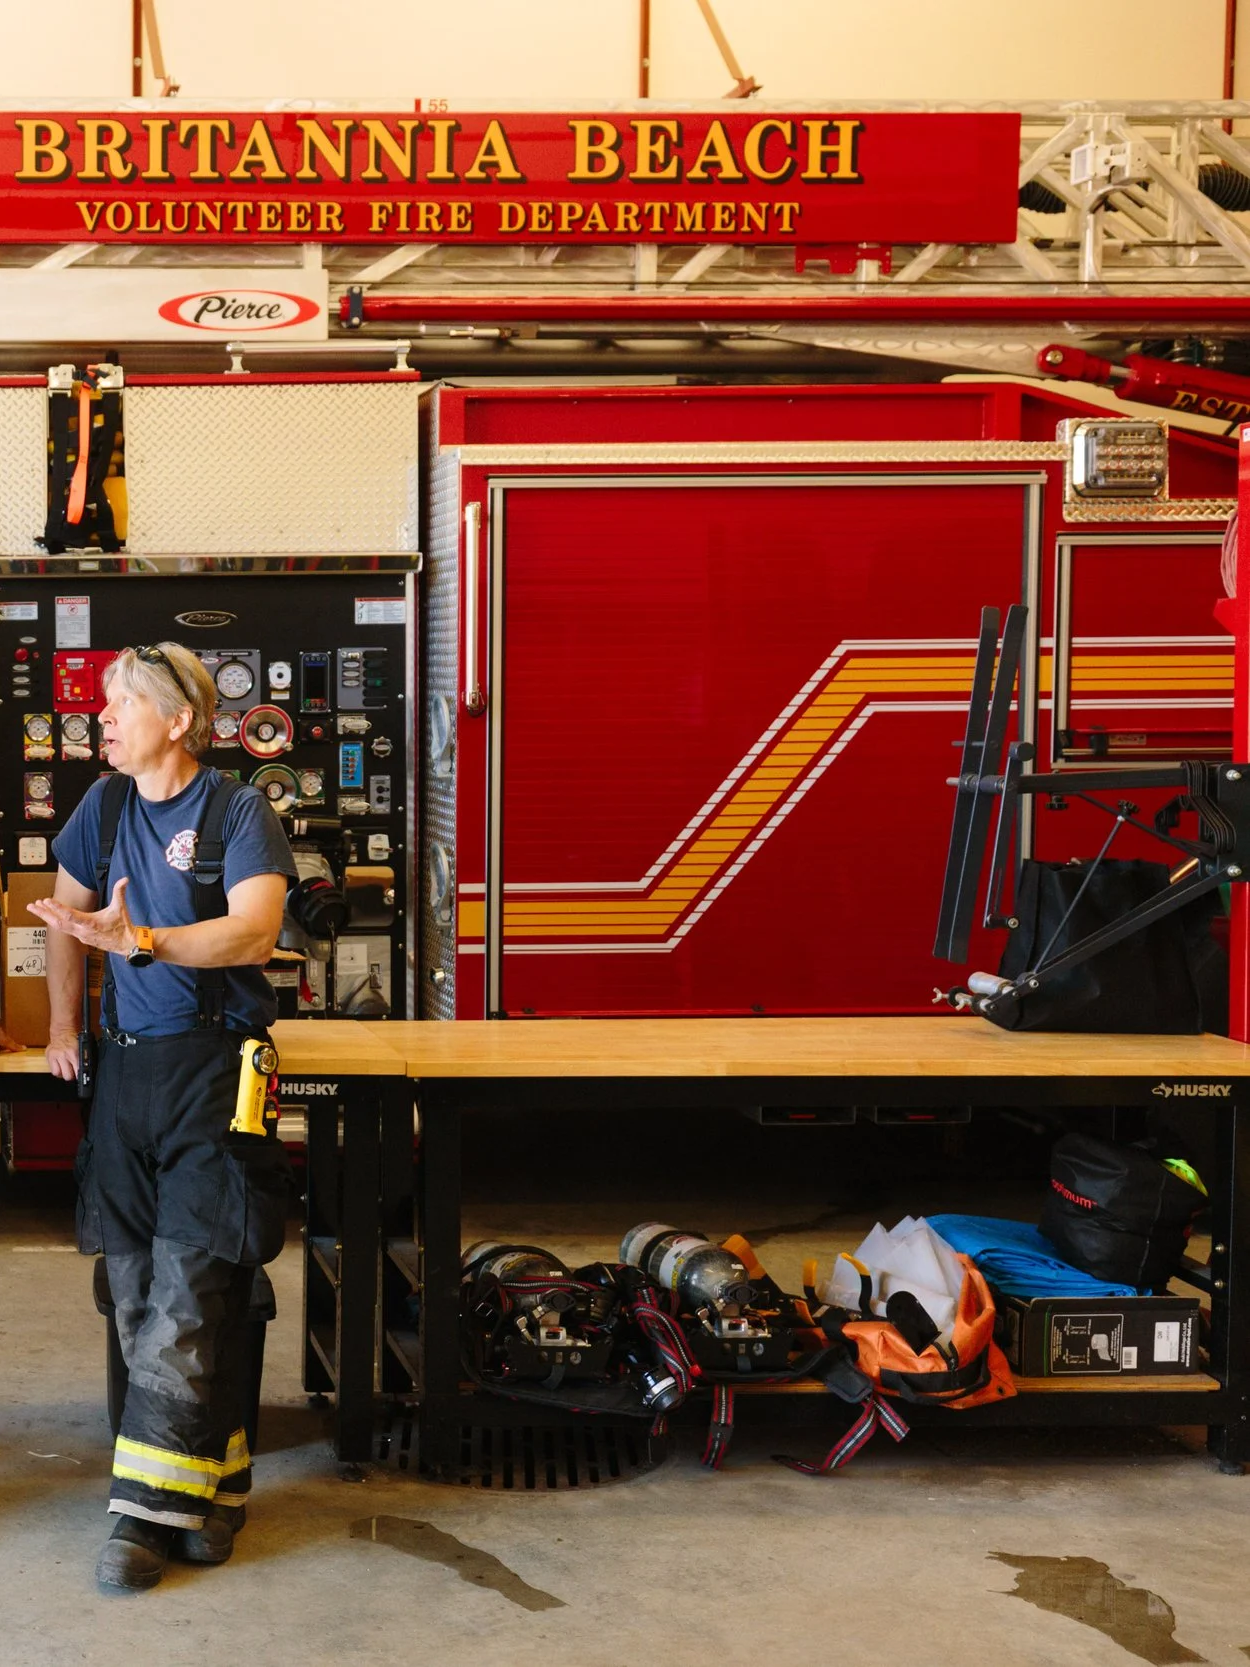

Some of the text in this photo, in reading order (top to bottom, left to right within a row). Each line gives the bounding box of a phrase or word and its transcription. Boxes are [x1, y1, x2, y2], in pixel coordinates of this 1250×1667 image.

[427, 98, 448, 112] 55
[16, 119, 862, 181] BRITANNIA BEACH
[77, 201, 800, 233] VOLUNTEER FIRE DEPARTMENT
[194, 294, 283, 324] Pierce
[281, 1083, 338, 1095] HUSKY
[1173, 1084, 1231, 1097] HUSKY
